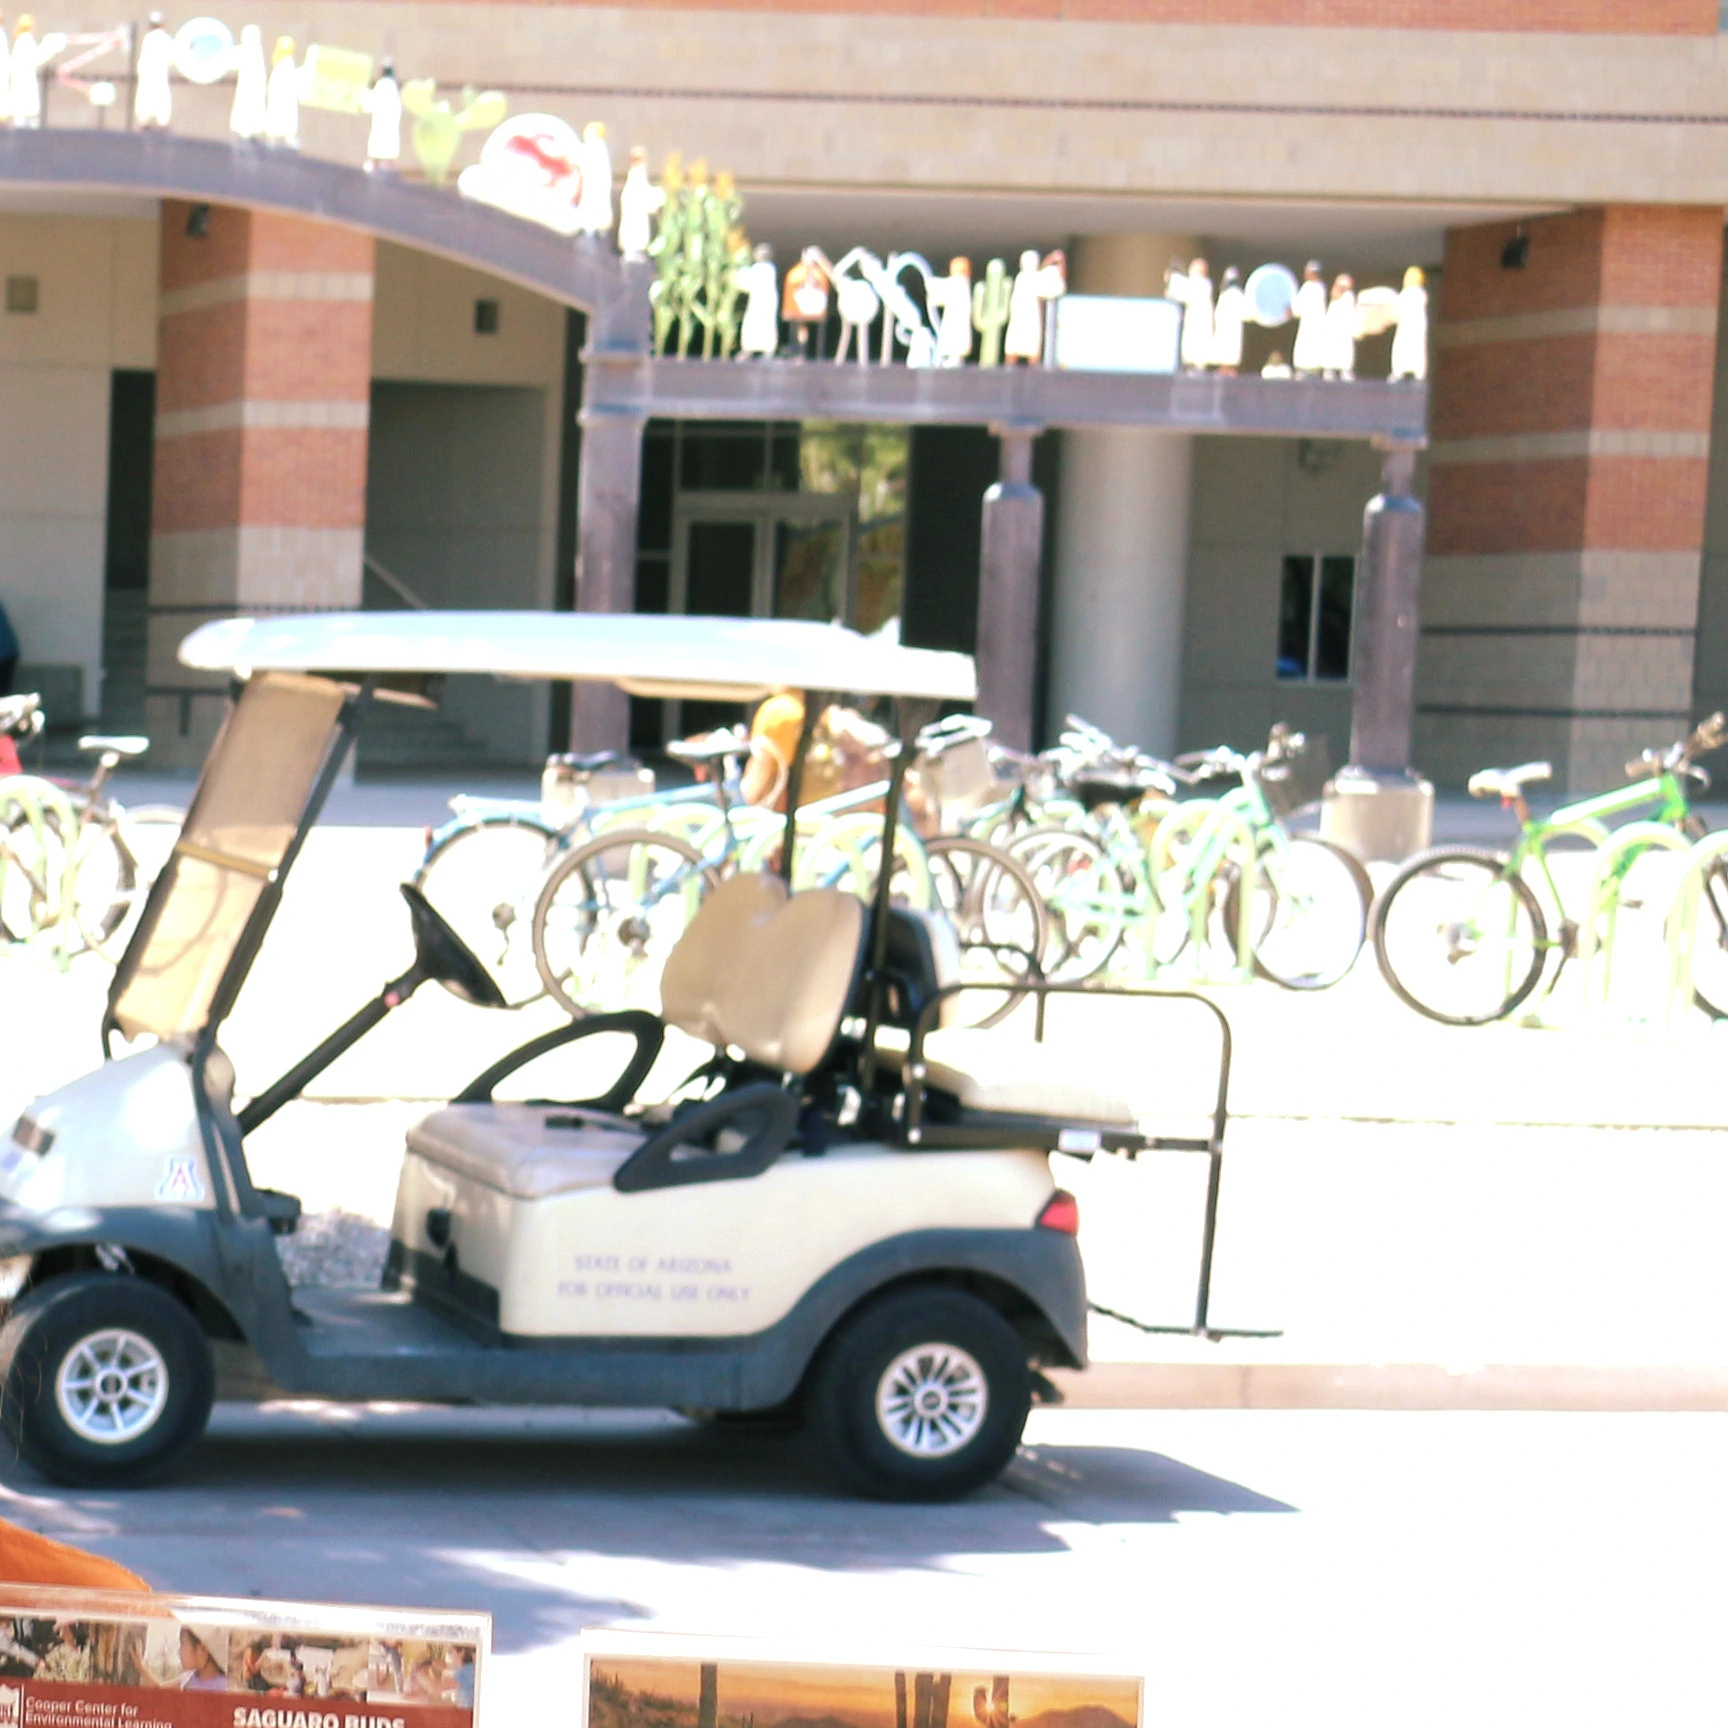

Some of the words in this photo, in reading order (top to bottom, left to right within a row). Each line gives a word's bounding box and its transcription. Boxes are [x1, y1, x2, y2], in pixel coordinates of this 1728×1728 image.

[574, 1255, 620, 1273] STATE
[628, 1255, 648, 1273] OF
[655, 1256, 733, 1274] ARIZONA
[556, 1281, 587, 1299] FOR
[595, 1282, 661, 1300] OFFICIAL
[671, 1282, 699, 1300] USE
[706, 1282, 750, 1301] ONLY
[26, 1696, 71, 1714] Cooper
[75, 1700, 118, 1716] Center
[121, 1702, 138, 1716] for
[25, 1709, 115, 1728] Environmental
